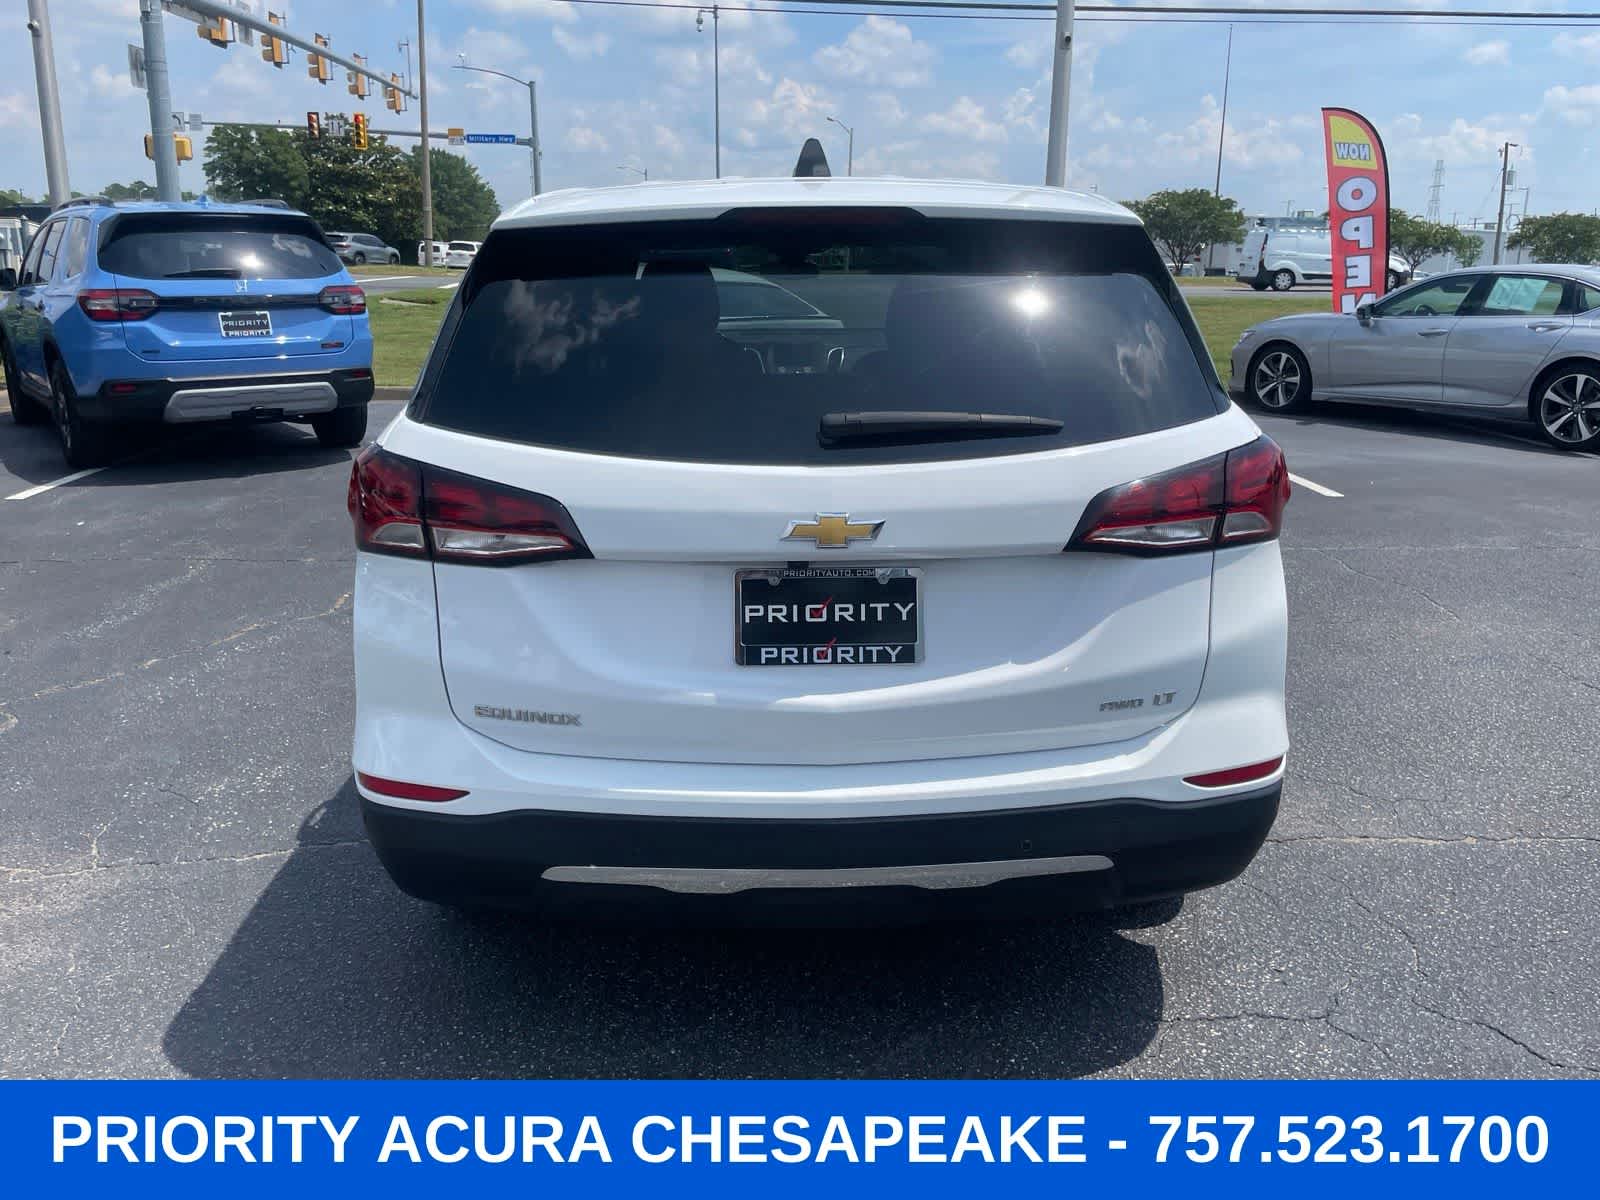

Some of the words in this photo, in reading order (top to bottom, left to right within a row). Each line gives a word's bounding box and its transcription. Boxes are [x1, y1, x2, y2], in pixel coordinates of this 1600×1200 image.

[498, 135, 514, 143] Hwy
[222, 319, 268, 327] PRIORITY
[228, 329, 268, 337] PRIORITY
[744, 602, 915, 624] PRIORITY
[760, 645, 903, 665] PRIORITY
[1152, 690, 1177, 706] LT
[474, 704, 582, 727] EQUINOX
